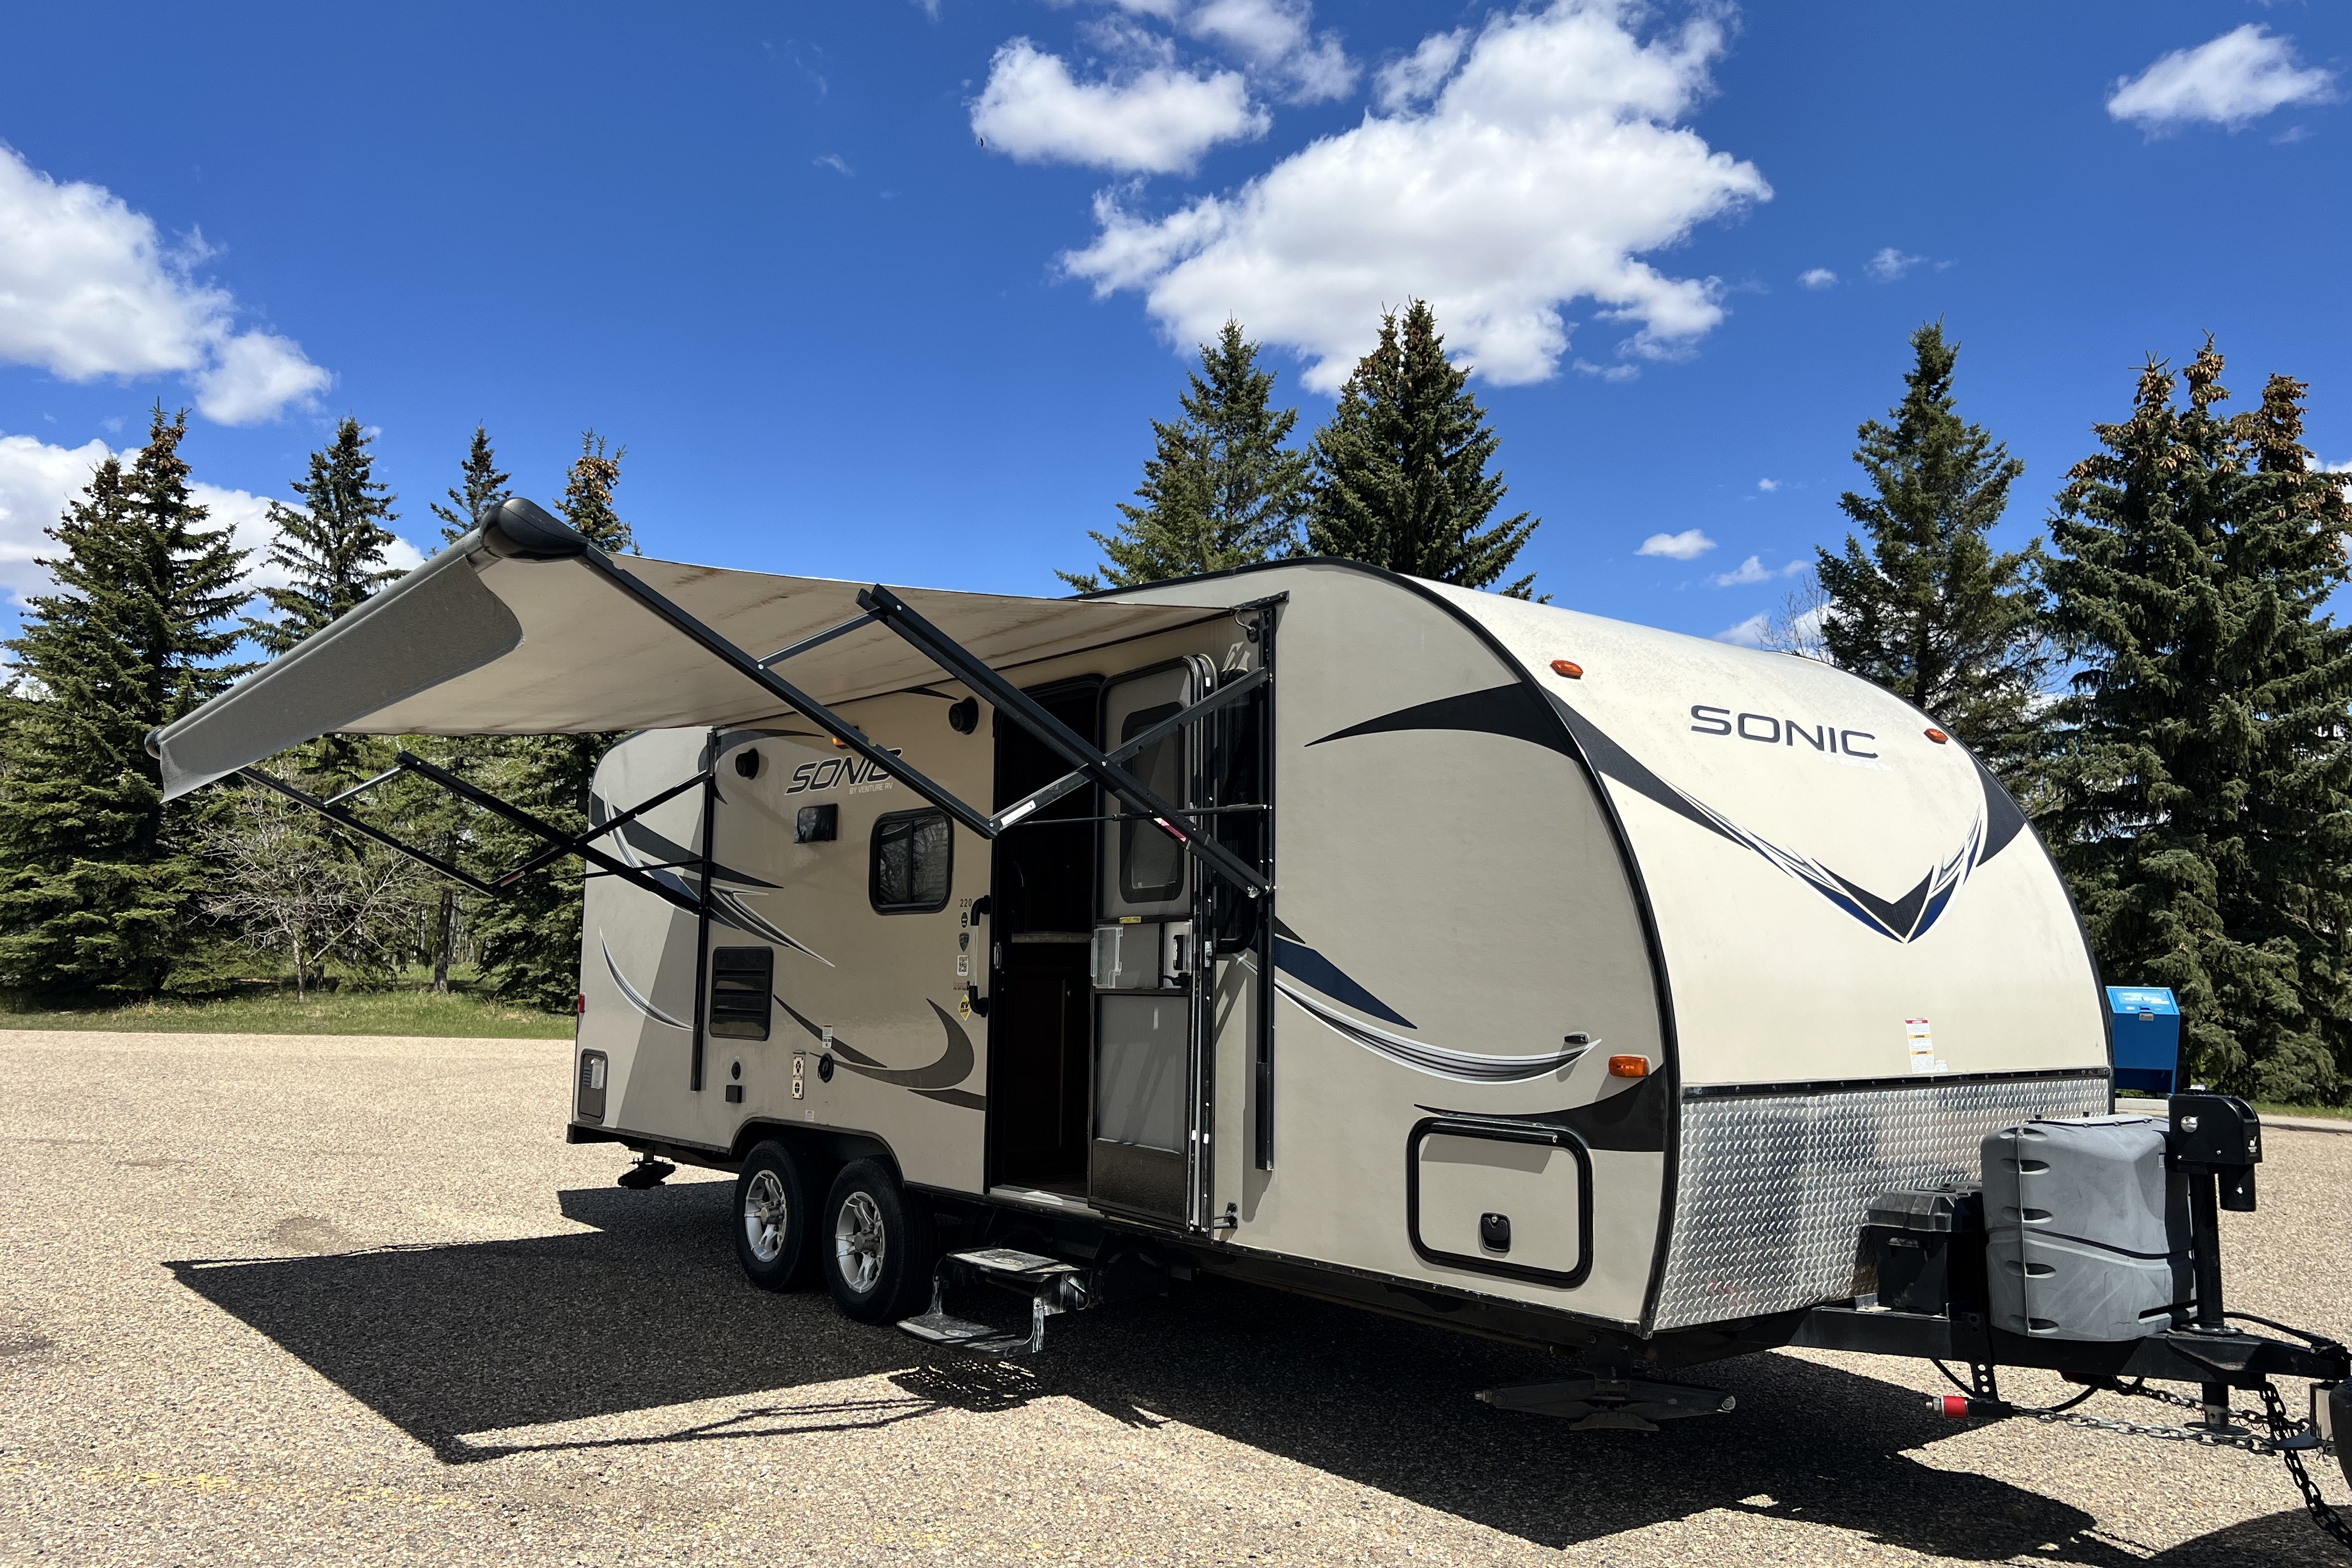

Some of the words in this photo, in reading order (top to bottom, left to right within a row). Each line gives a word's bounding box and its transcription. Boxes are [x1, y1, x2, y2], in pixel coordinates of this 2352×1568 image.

[1690, 705, 1879, 759] SONIC
[849, 786, 858, 794] BY
[858, 783, 884, 793] VENTURE
[960, 898, 972, 908] 220
[960, 1001, 969, 1009] RV
